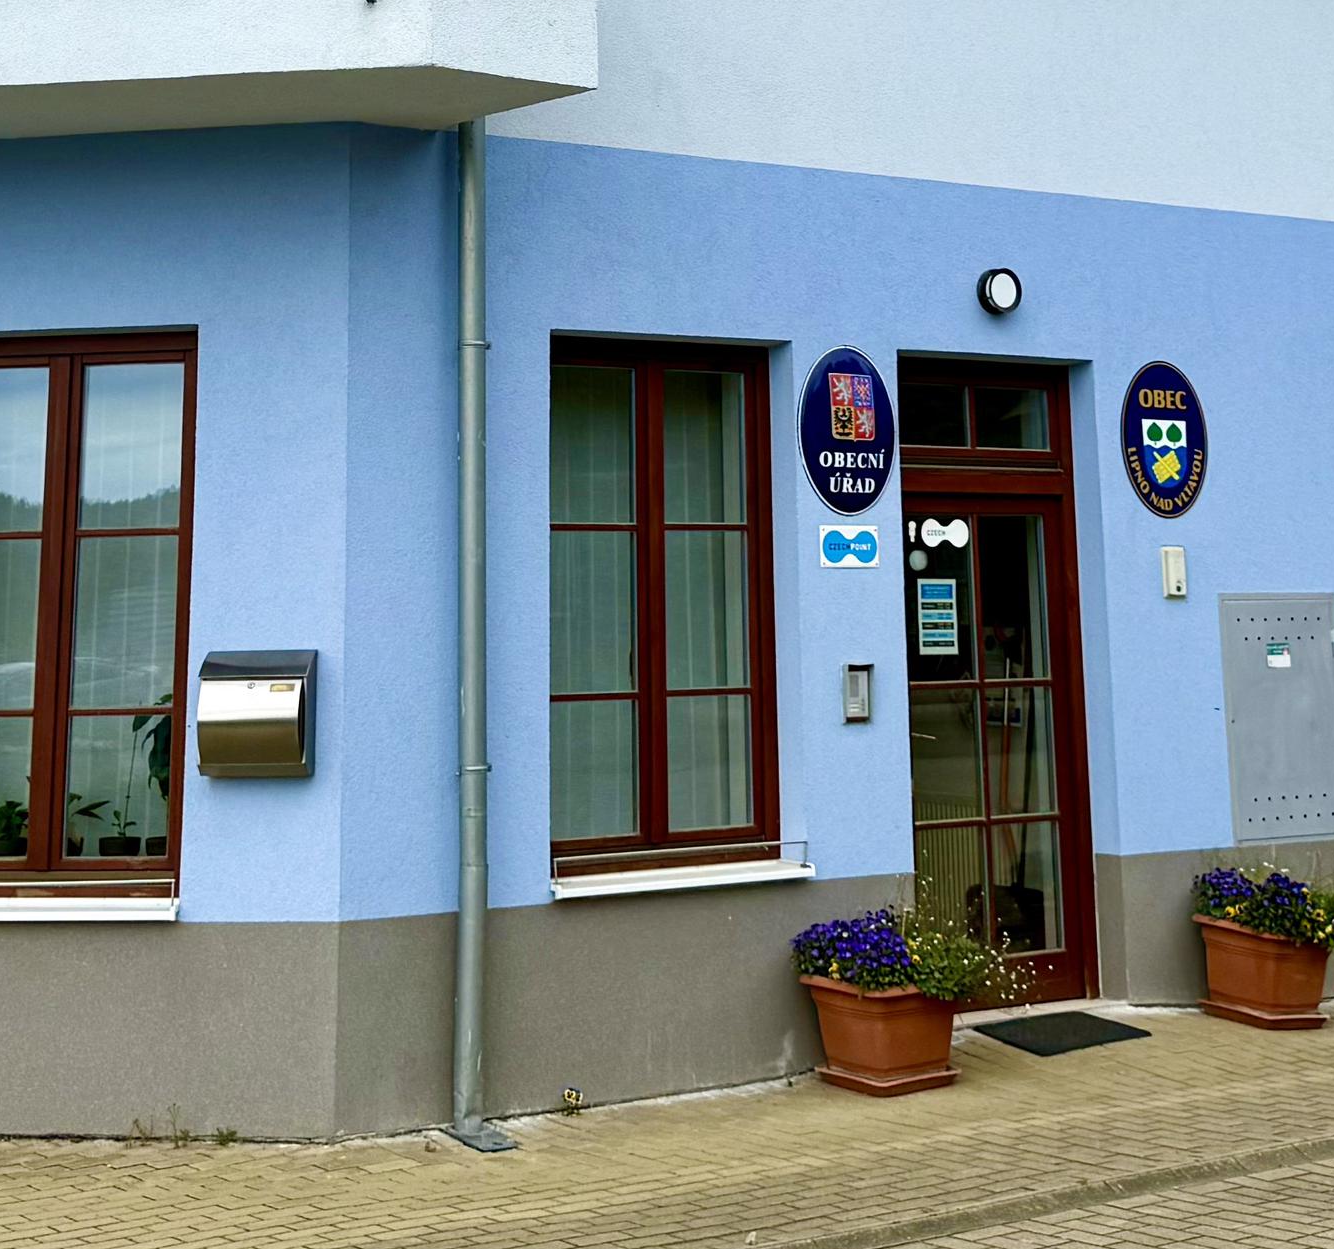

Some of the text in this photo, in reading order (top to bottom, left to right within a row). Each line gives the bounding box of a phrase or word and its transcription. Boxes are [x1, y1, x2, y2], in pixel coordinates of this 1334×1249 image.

[1138, 388, 1187, 410] OBEC
[819, 449, 885, 469] OBECNÍ
[829, 472, 876, 493] ÚŘAD
[1127, 447, 1204, 511] LIPNO NAD VLTAVOU
